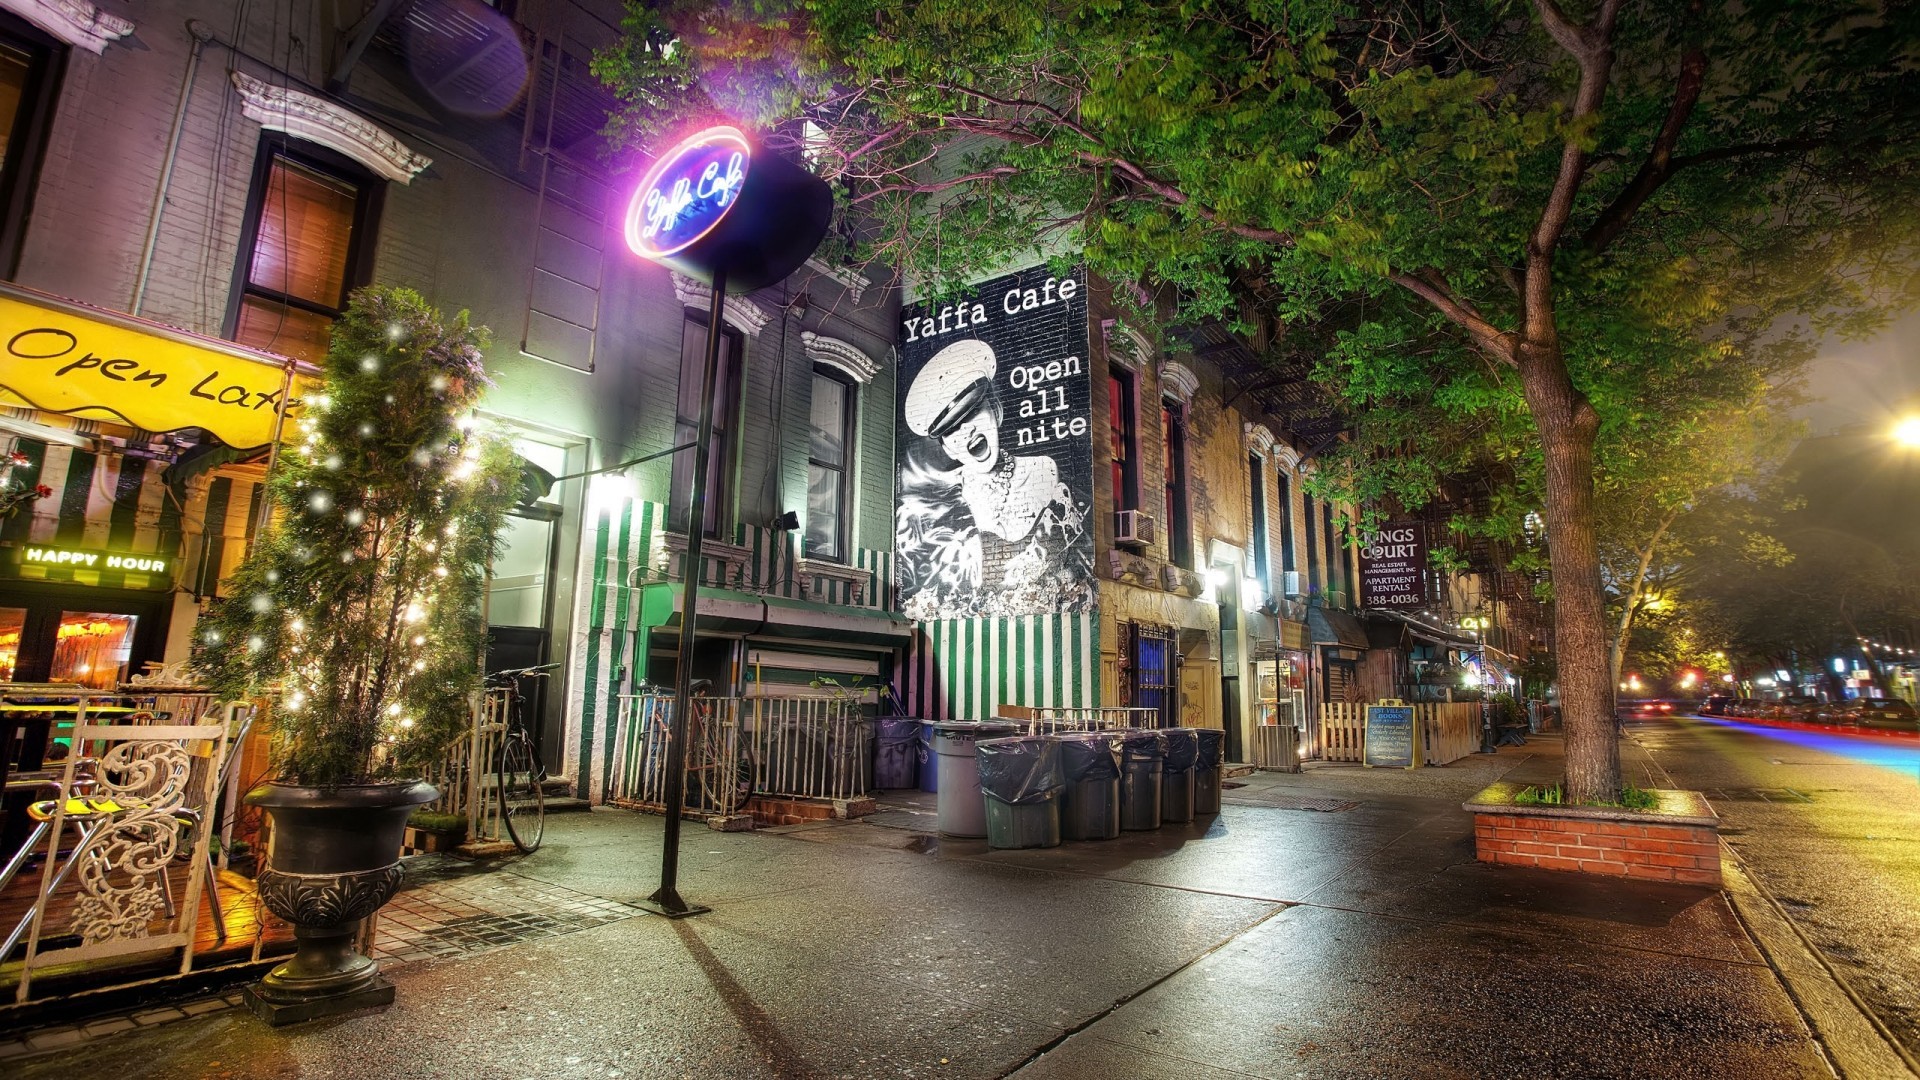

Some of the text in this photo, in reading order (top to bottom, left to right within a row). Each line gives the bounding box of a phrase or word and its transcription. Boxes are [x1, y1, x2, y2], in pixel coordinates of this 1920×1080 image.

[904, 277, 1077, 343] Yaffa Cafe
[7, 328, 302, 418] Open Late
[1010, 355, 1082, 391] Open
[1019, 386, 1070, 418] all
[1017, 416, 1087, 446] nite
[27, 548, 165, 572] HAPPY HOUR
[1360, 544, 1418, 560] COURT
[1365, 576, 1417, 585] APARTMENT
[1372, 584, 1411, 592] RENTALS
[1366, 594, 1419, 605] 388-0036
